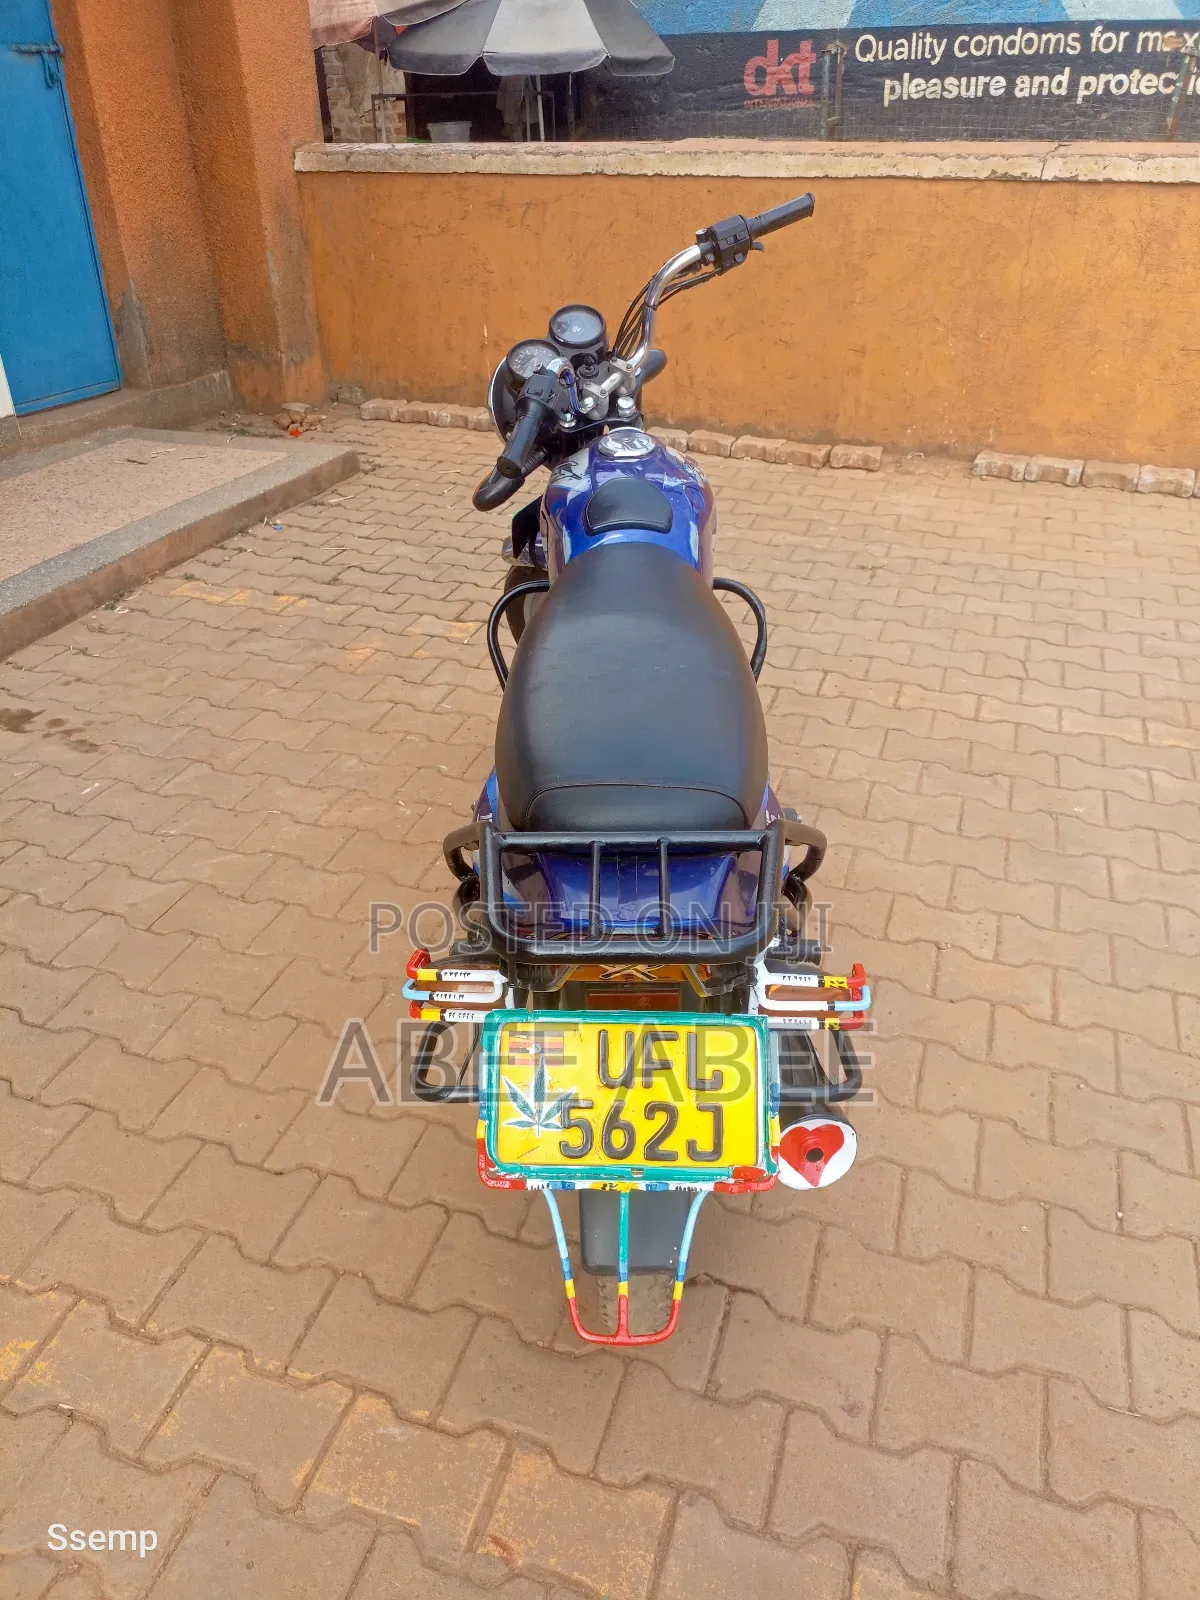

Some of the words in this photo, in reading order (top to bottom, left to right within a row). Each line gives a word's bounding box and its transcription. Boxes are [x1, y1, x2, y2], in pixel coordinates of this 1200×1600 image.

[743, 39, 817, 96] dkt
[855, 32, 948, 65] Quality
[953, 27, 1081, 58] condoms
[1090, 25, 1130, 54] for
[884, 73, 1007, 107] pleasure
[1015, 67, 1071, 98] and
[598, 1029, 723, 1091] UFL
[559, 1099, 723, 1162] 562J
